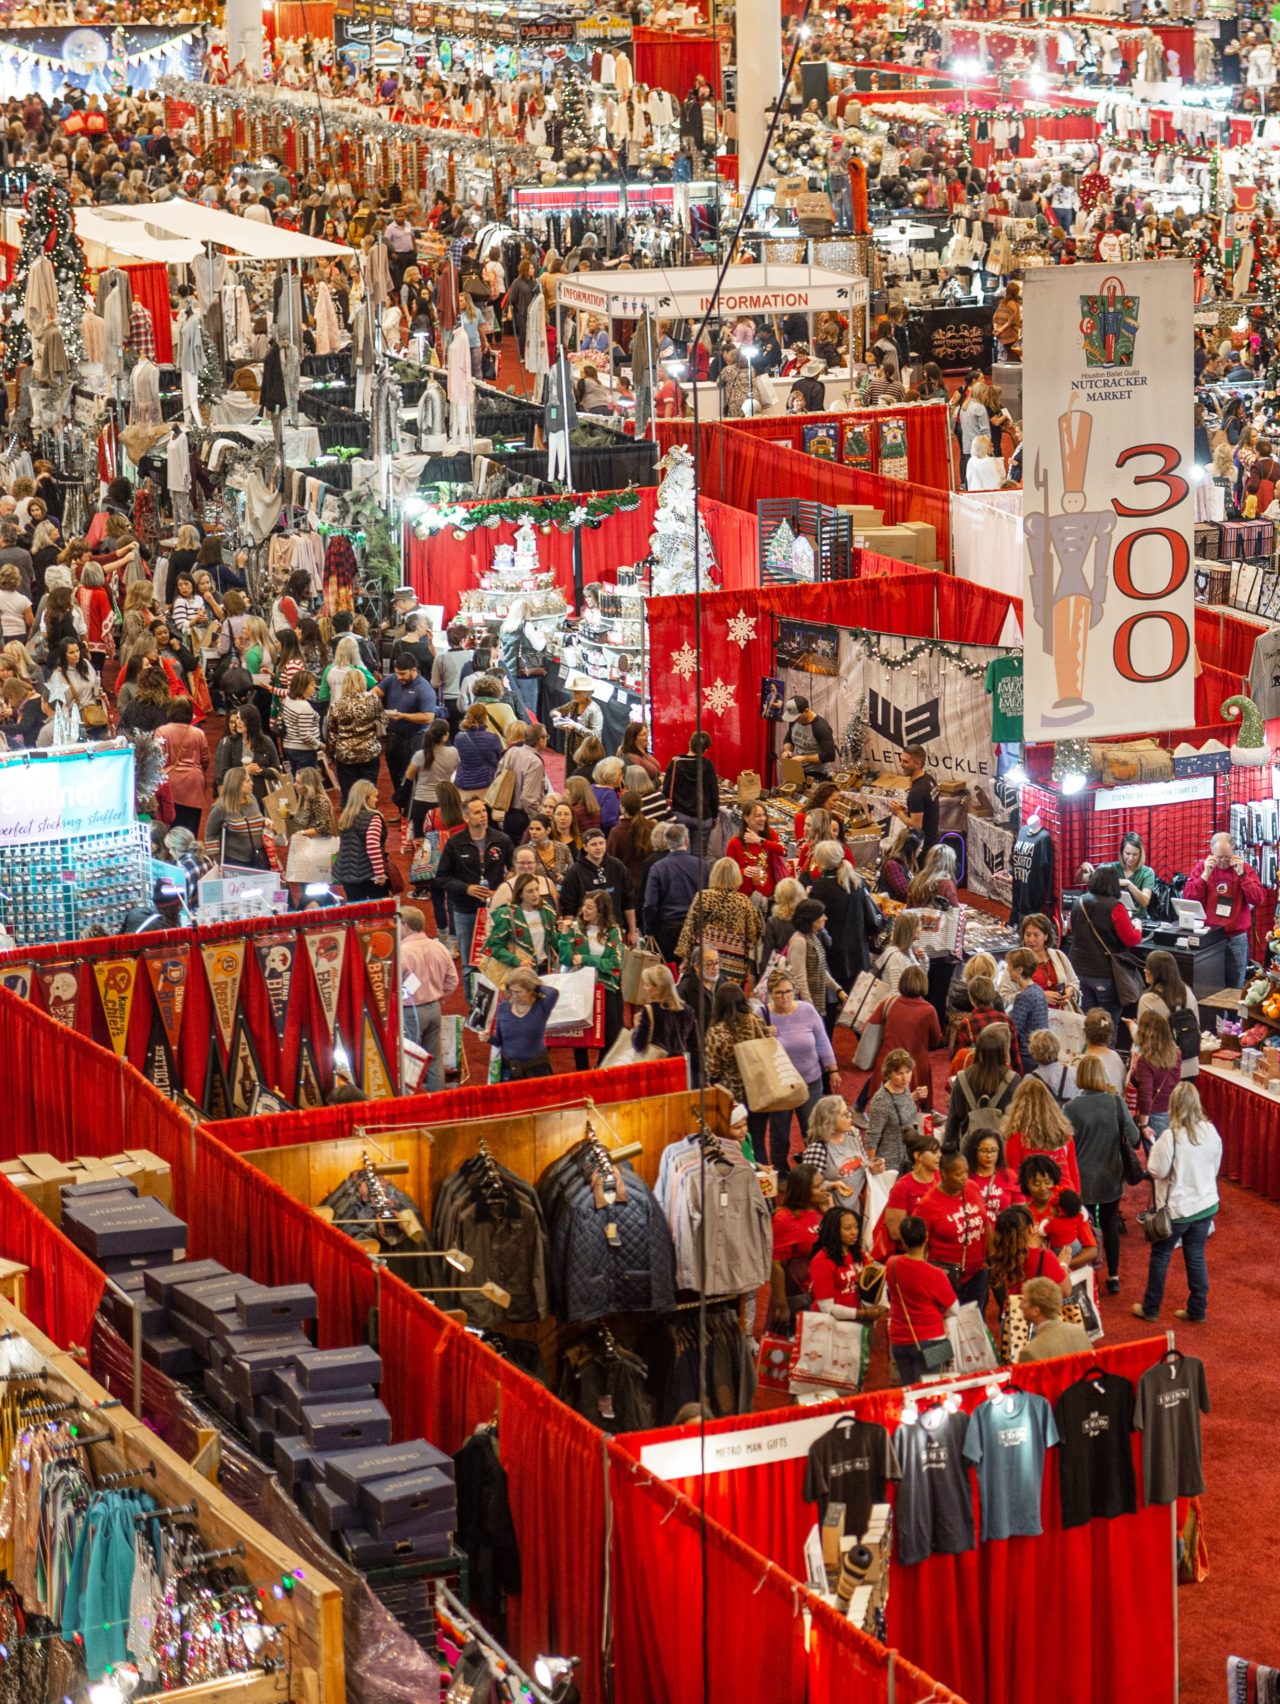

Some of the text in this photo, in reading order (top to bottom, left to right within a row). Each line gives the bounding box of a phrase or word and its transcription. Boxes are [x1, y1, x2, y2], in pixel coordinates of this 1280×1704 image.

[562, 286, 606, 307] INFORMATION
[699, 292, 809, 312] INFORMATION
[933, 335, 983, 347] ANYTHING BLING
[1071, 376, 1149, 391] NUTCRACKER
[1080, 369, 1140, 380] Houston Ballet Guild
[1086, 389, 1133, 402] MARKET
[1111, 443, 1190, 684] 300
[997, 682, 1024, 694] AMAZ
[999, 697, 1024, 709] AMAZ
[926, 754, 989, 776] UCKLE
[38, 814, 82, 833] stocking
[282, 971, 291, 1001] BUFFALO
[317, 970, 332, 1013] FALCONS
[367, 963, 386, 1013] BROWNS
[175, 986, 184, 1013] DENVER
[213, 980, 231, 1030] REDSKINS
[267, 978, 283, 1017] BILLS
[154, 1045, 170, 1087] COLLEGE
[715, 1437, 788, 1458] METRO MAN GIFTS
